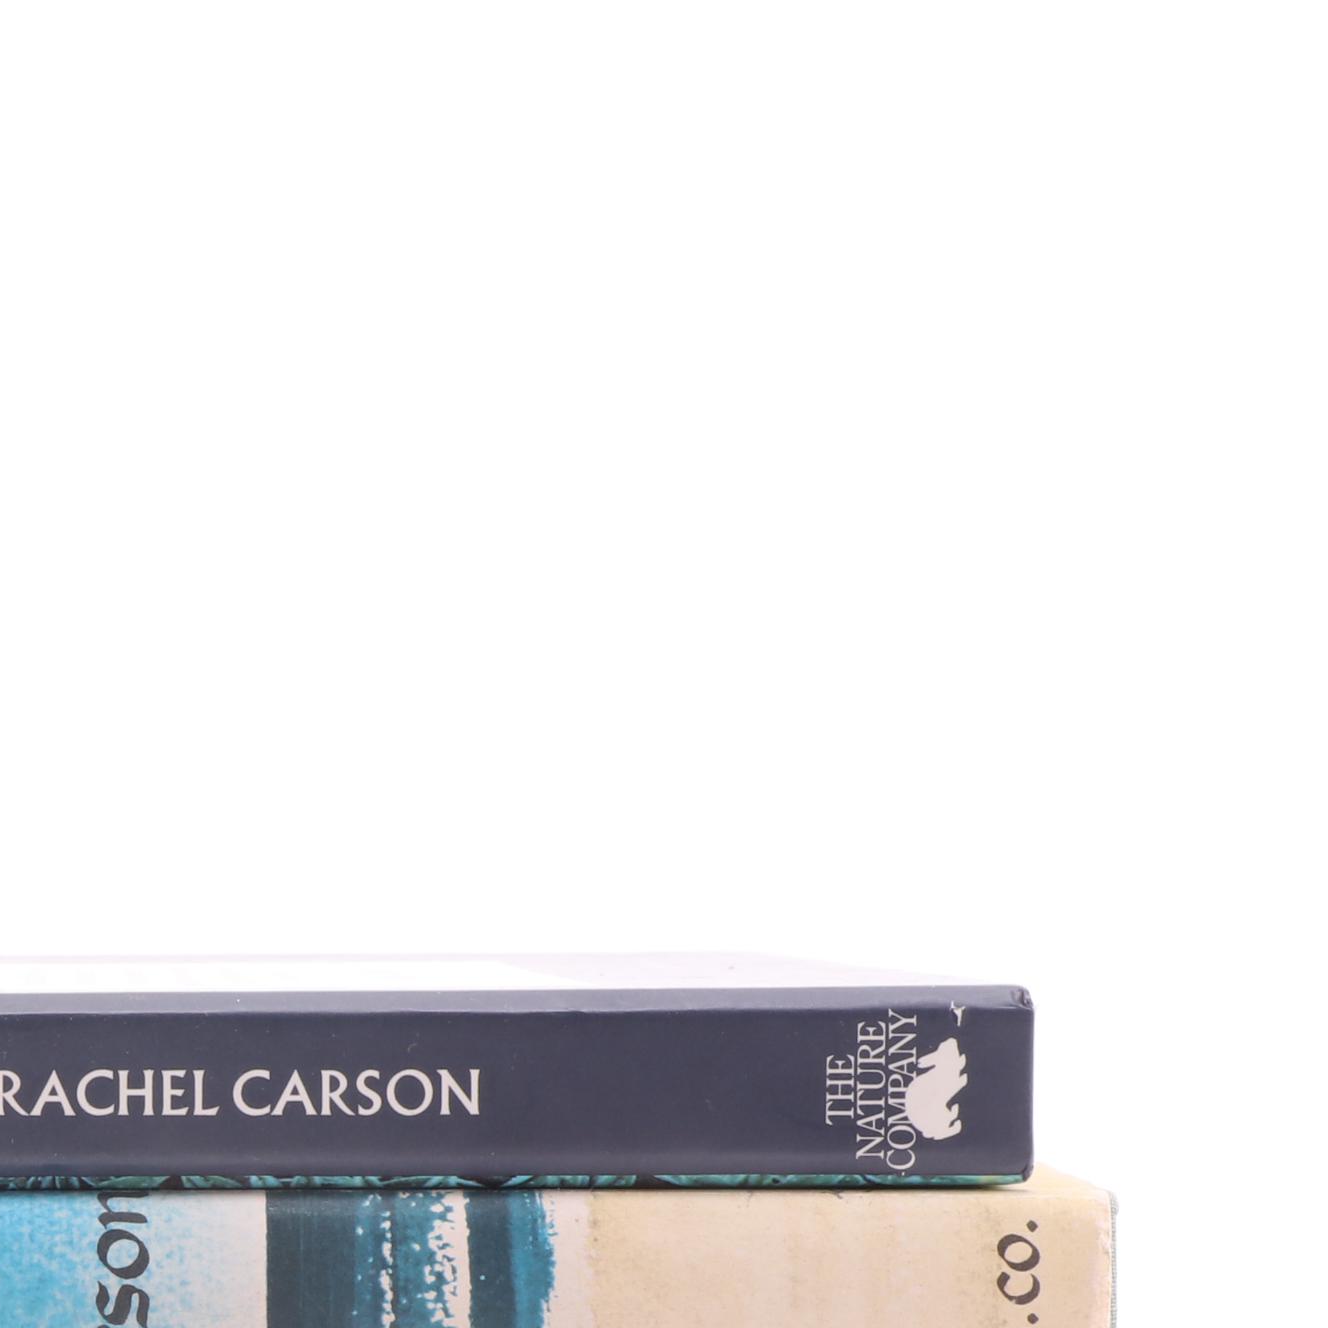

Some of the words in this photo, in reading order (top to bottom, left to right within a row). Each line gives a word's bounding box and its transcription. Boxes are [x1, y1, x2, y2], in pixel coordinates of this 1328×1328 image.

[232, 1067, 481, 1116] CARSON
[825, 1054, 856, 1127] THE
[856, 1020, 886, 1160] NATURE
[886, 1008, 917, 1170] COMPANY
